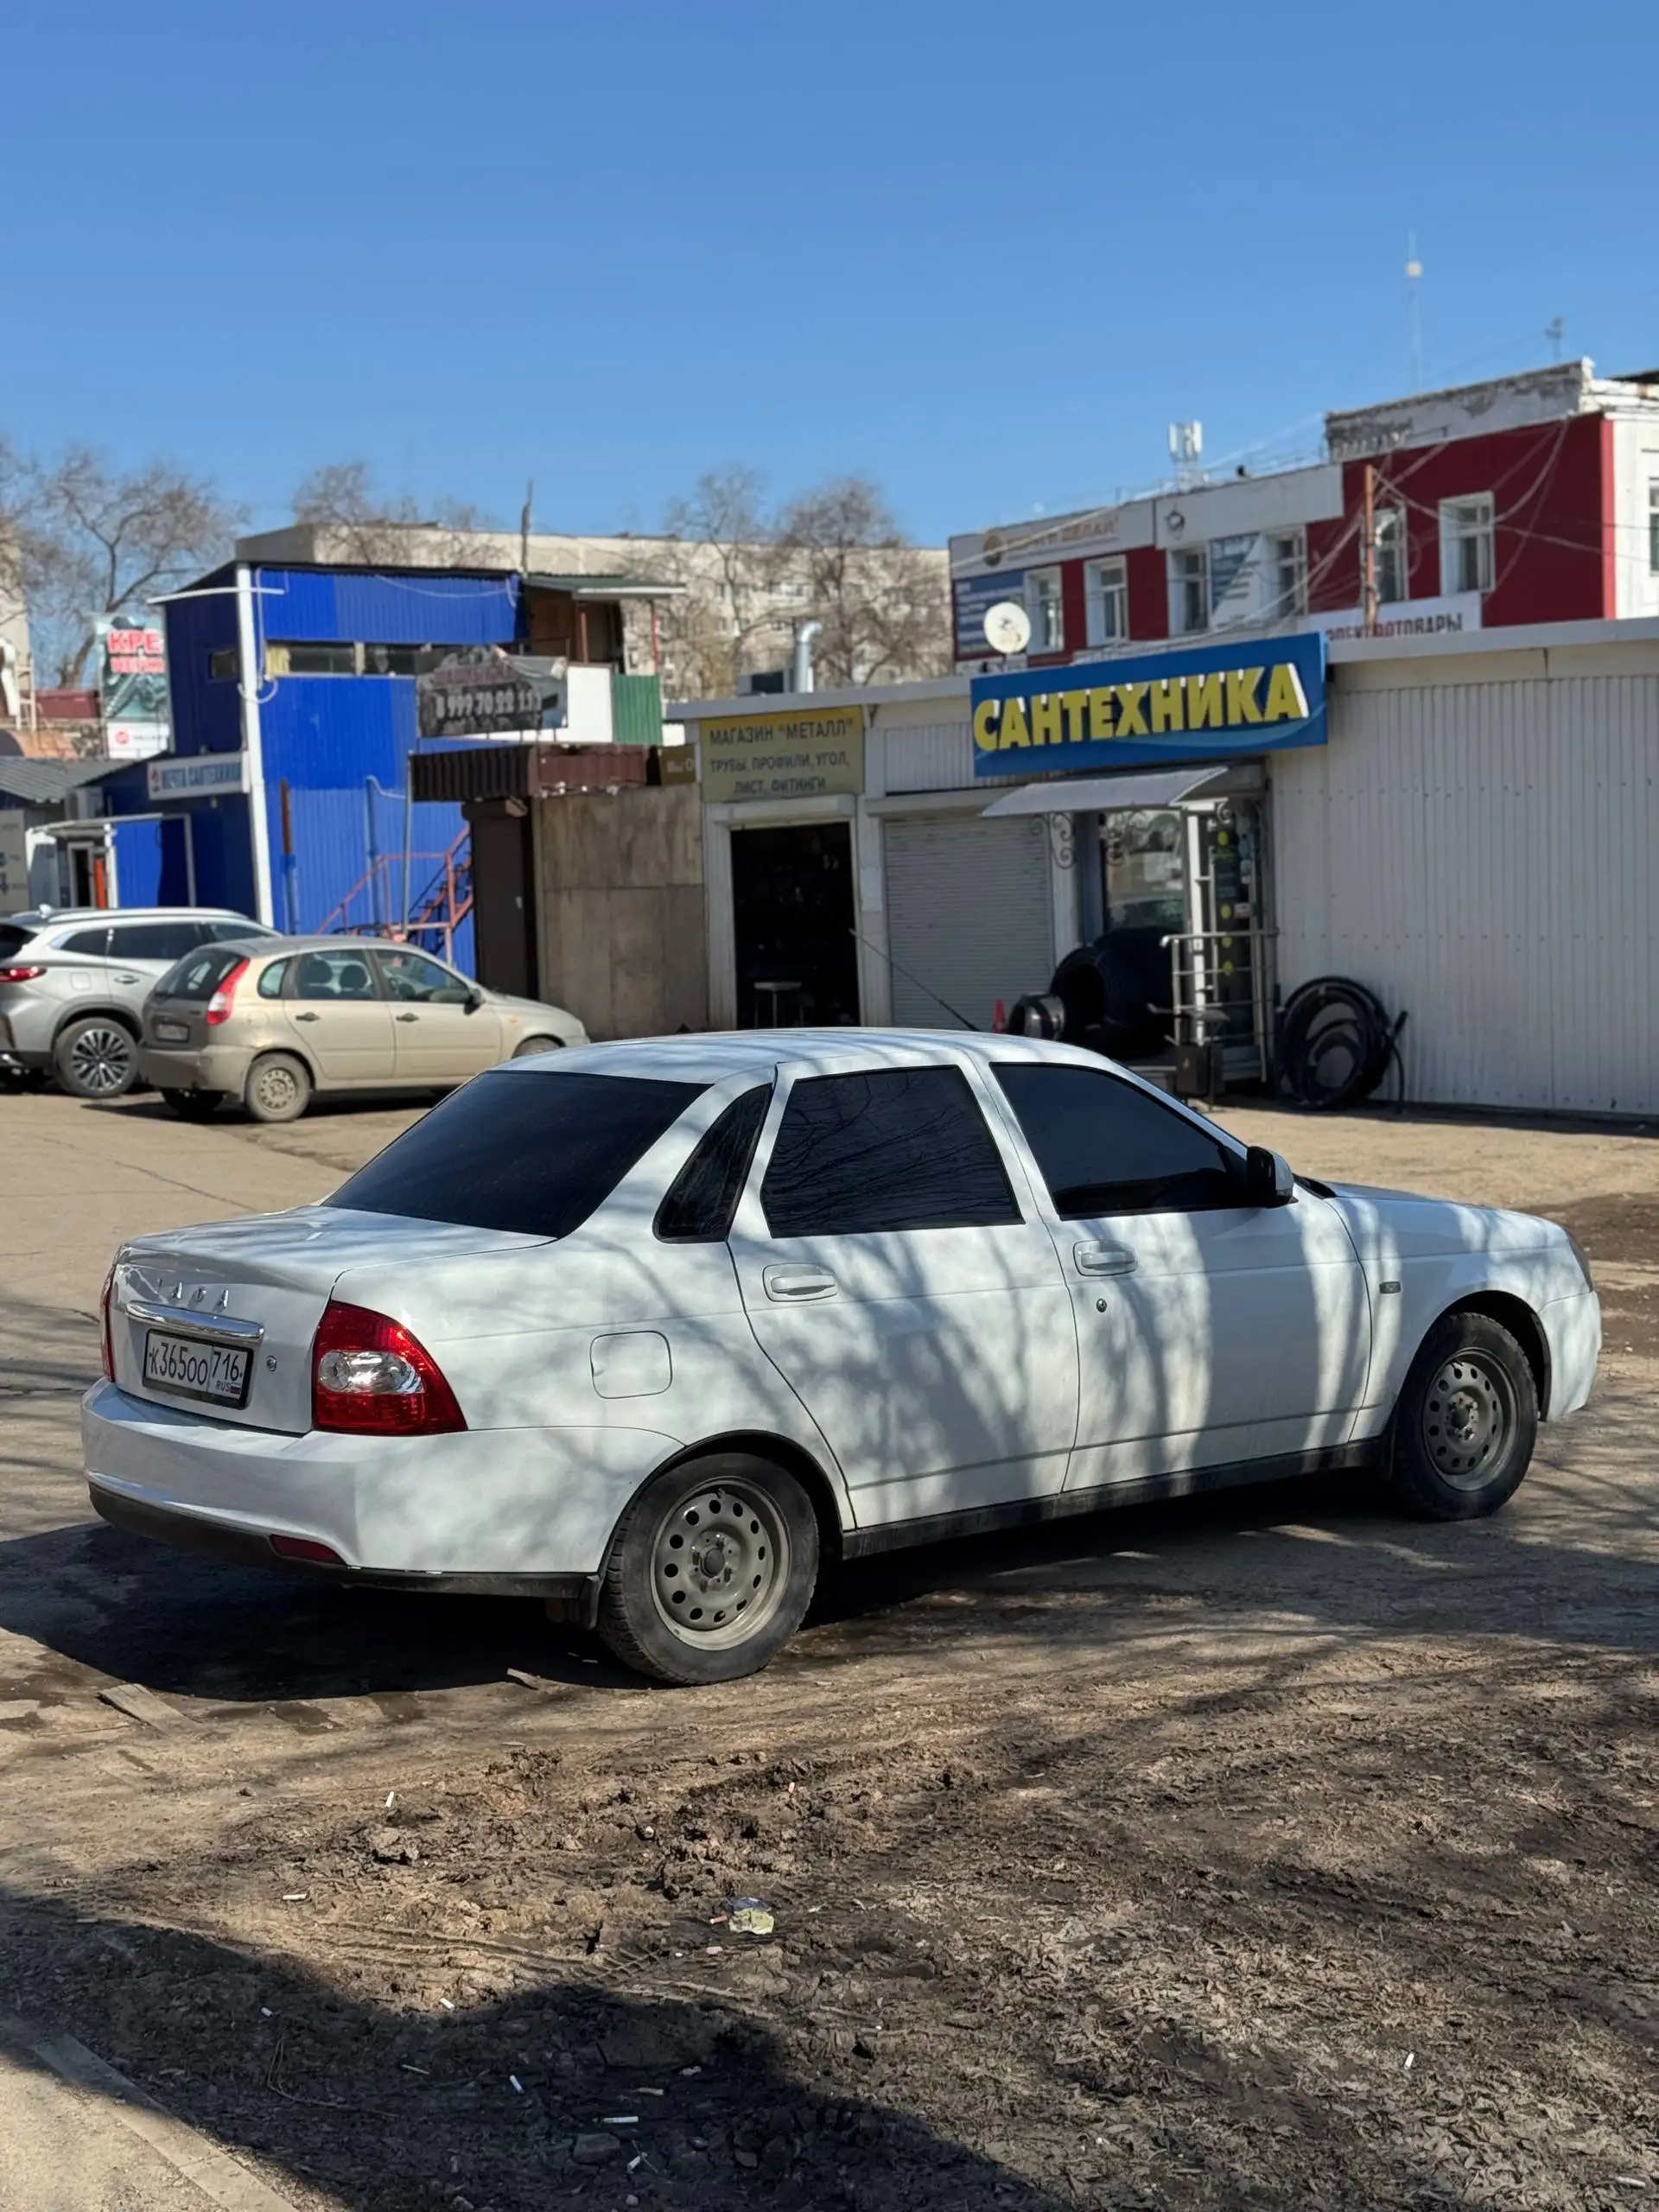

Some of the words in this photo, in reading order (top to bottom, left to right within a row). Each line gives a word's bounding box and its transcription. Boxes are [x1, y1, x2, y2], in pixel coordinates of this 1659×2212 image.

[973, 663, 1310, 751] САНТЕХНИКА
[710, 728, 773, 745] МАГАЗИН
[771, 777, 826, 792] ФИТИНГИ
[213, 1351, 239, 1382] 716
[216, 1380, 231, 1392] RUS
